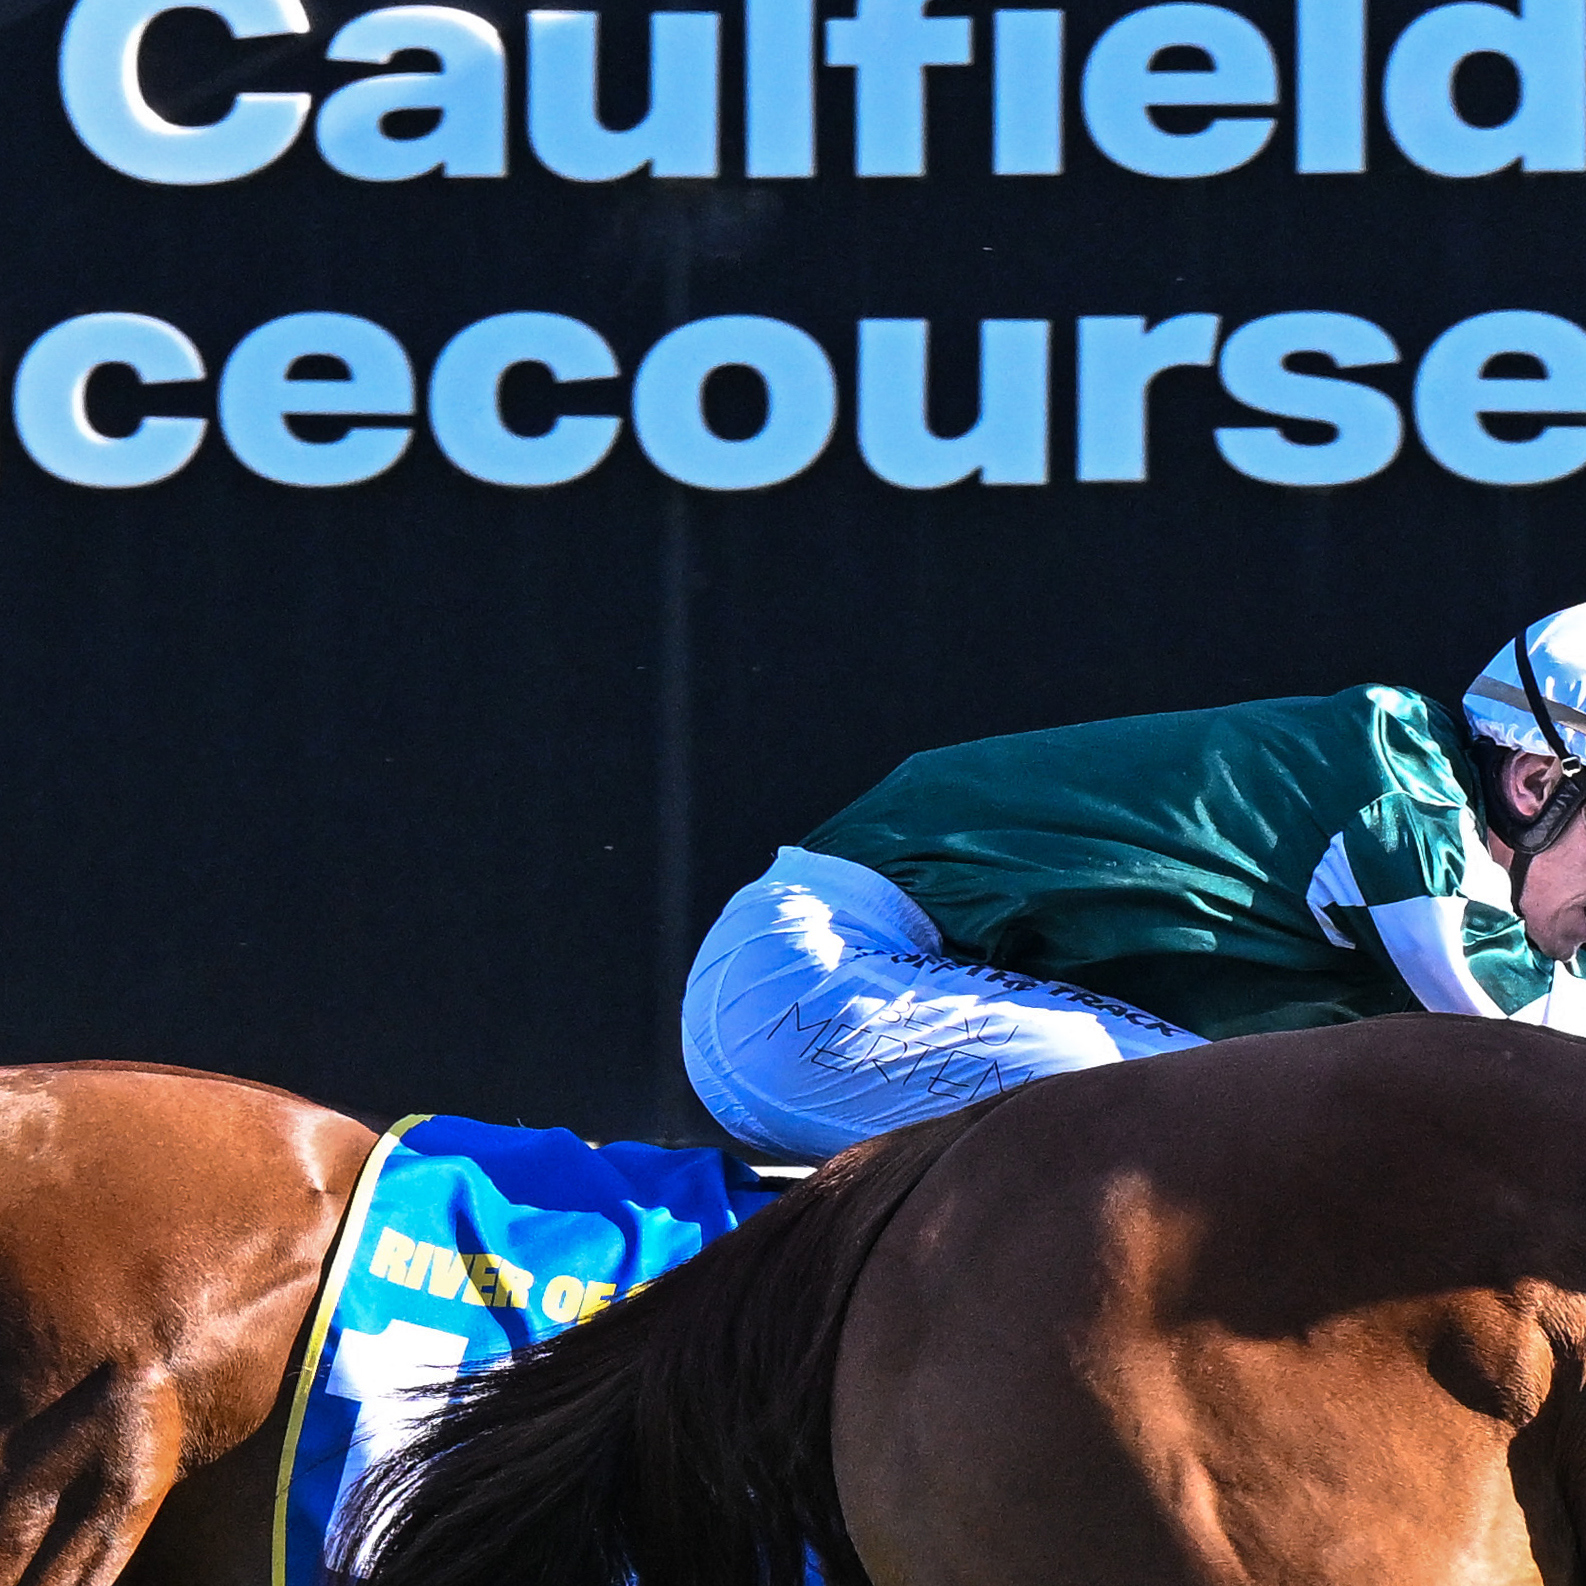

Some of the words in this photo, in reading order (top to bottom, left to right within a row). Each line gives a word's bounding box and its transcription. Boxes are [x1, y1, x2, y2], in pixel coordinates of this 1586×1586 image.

[879, 998, 1019, 1046] BEAU
[1048, 984, 1186, 1038] TRACK
[368, 1226, 535, 1310] RIVER
[541, 1274, 618, 1325] OF
